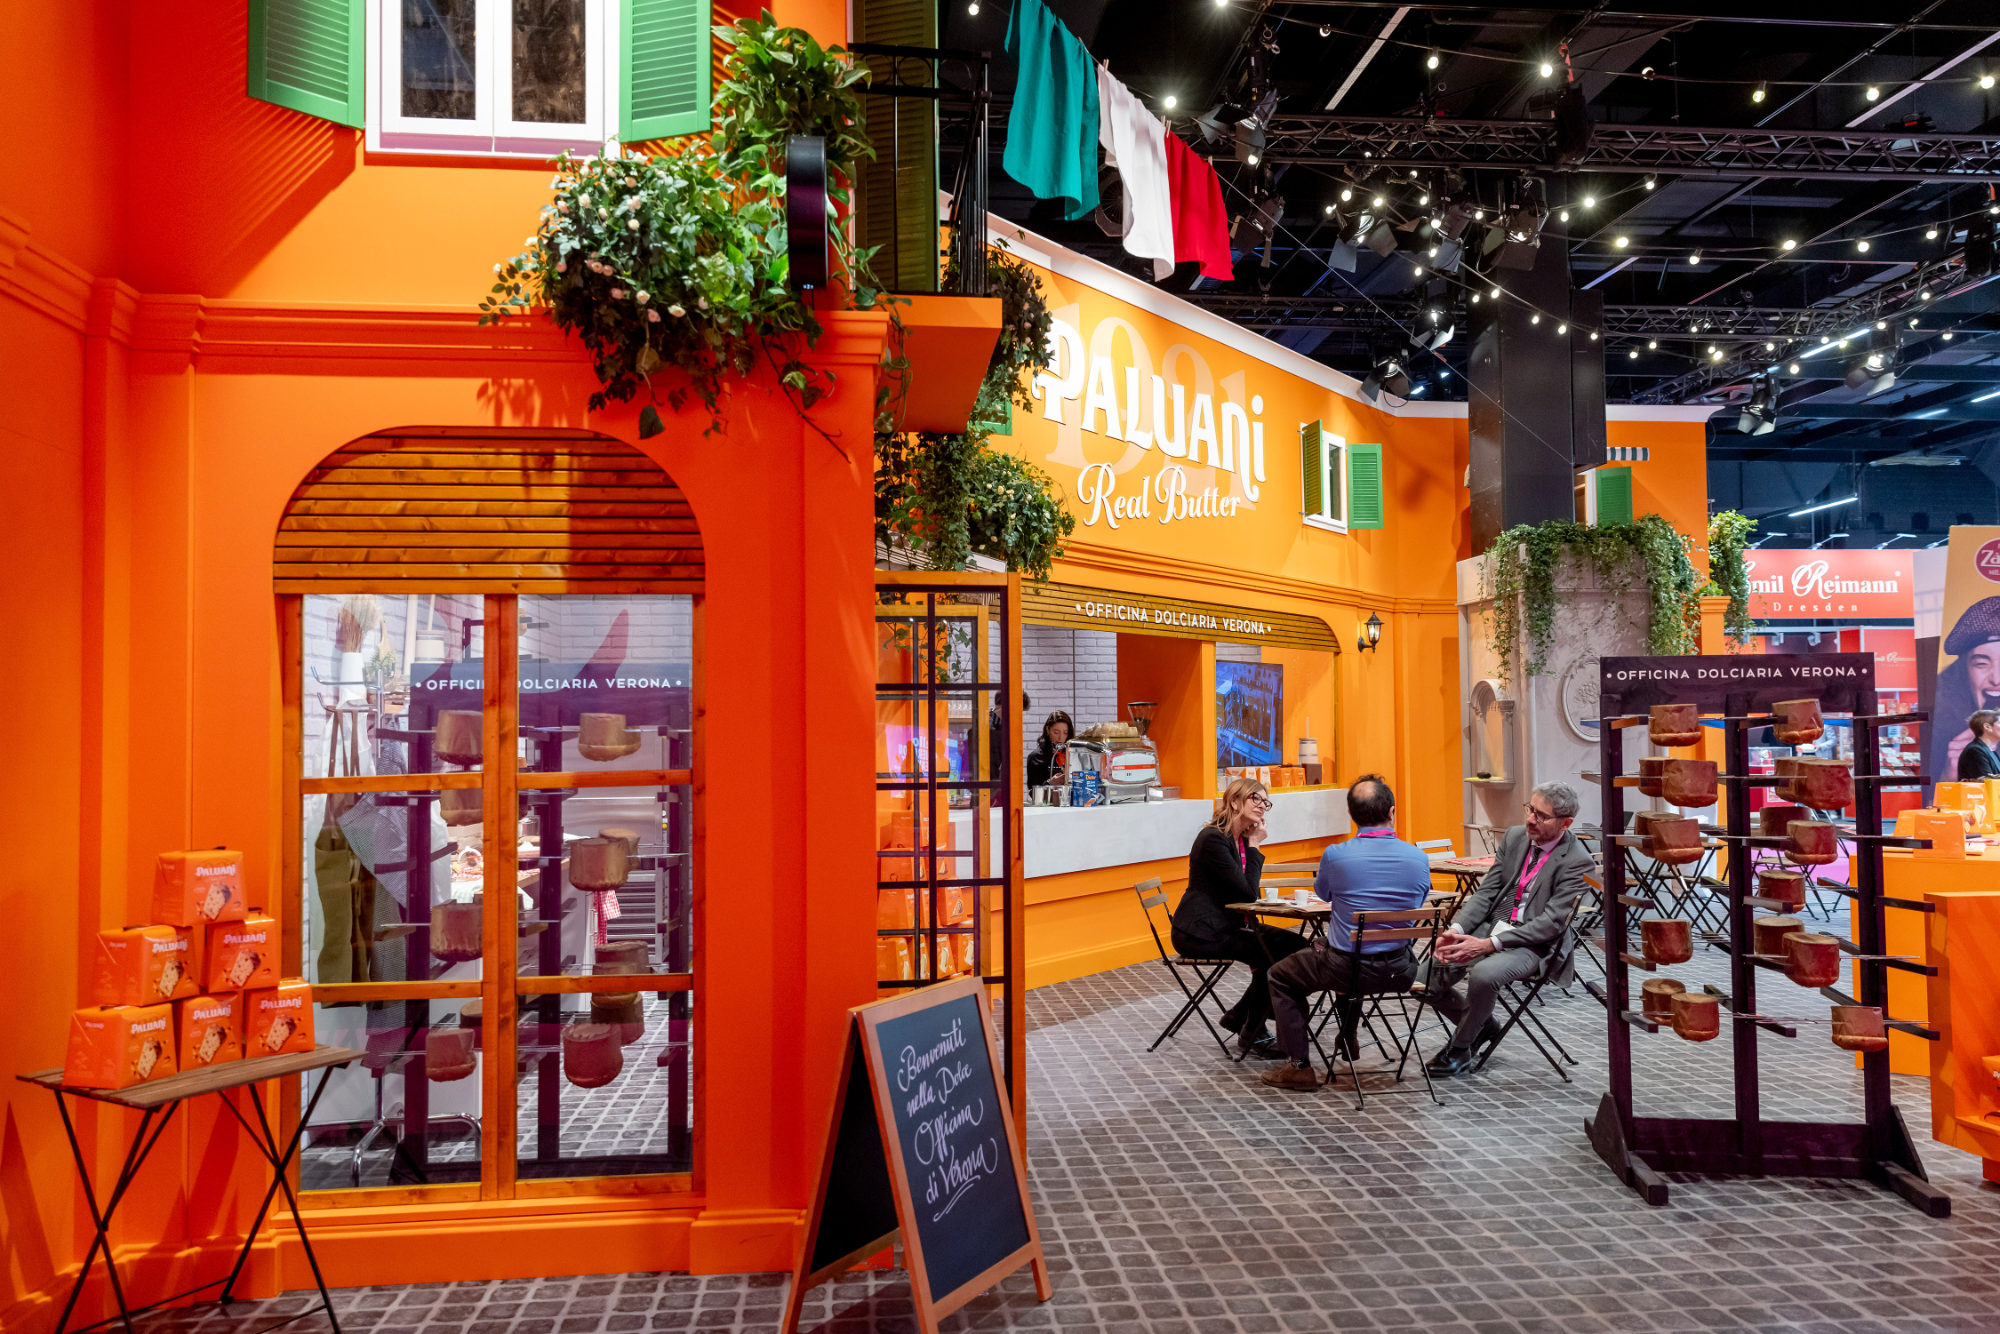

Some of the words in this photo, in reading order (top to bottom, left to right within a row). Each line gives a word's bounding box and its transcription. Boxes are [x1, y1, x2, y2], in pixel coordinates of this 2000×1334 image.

[1078, 463, 1151, 529] Real
[1155, 466, 1241, 524] Butter
[1791, 560, 1898, 600] Reimann
[1085, 601, 1148, 622] OFFICINA
[1154, 609, 1217, 630] DOLCIARIA
[1222, 617, 1265, 635] VERONA
[605, 678, 672, 689] VERONA
[1616, 669, 1690, 681] OFFICINA
[1697, 667, 1783, 680] DOLCIARIA
[1791, 666, 1857, 678] VERONA
[897, 1017, 967, 1092] Benvenuti
[906, 1080, 937, 1118] nella
[936, 1060, 973, 1105] Dolce
[914, 1097, 984, 1165] Officina
[926, 1171, 940, 1204] di
[939, 1137, 998, 1195] Verona
